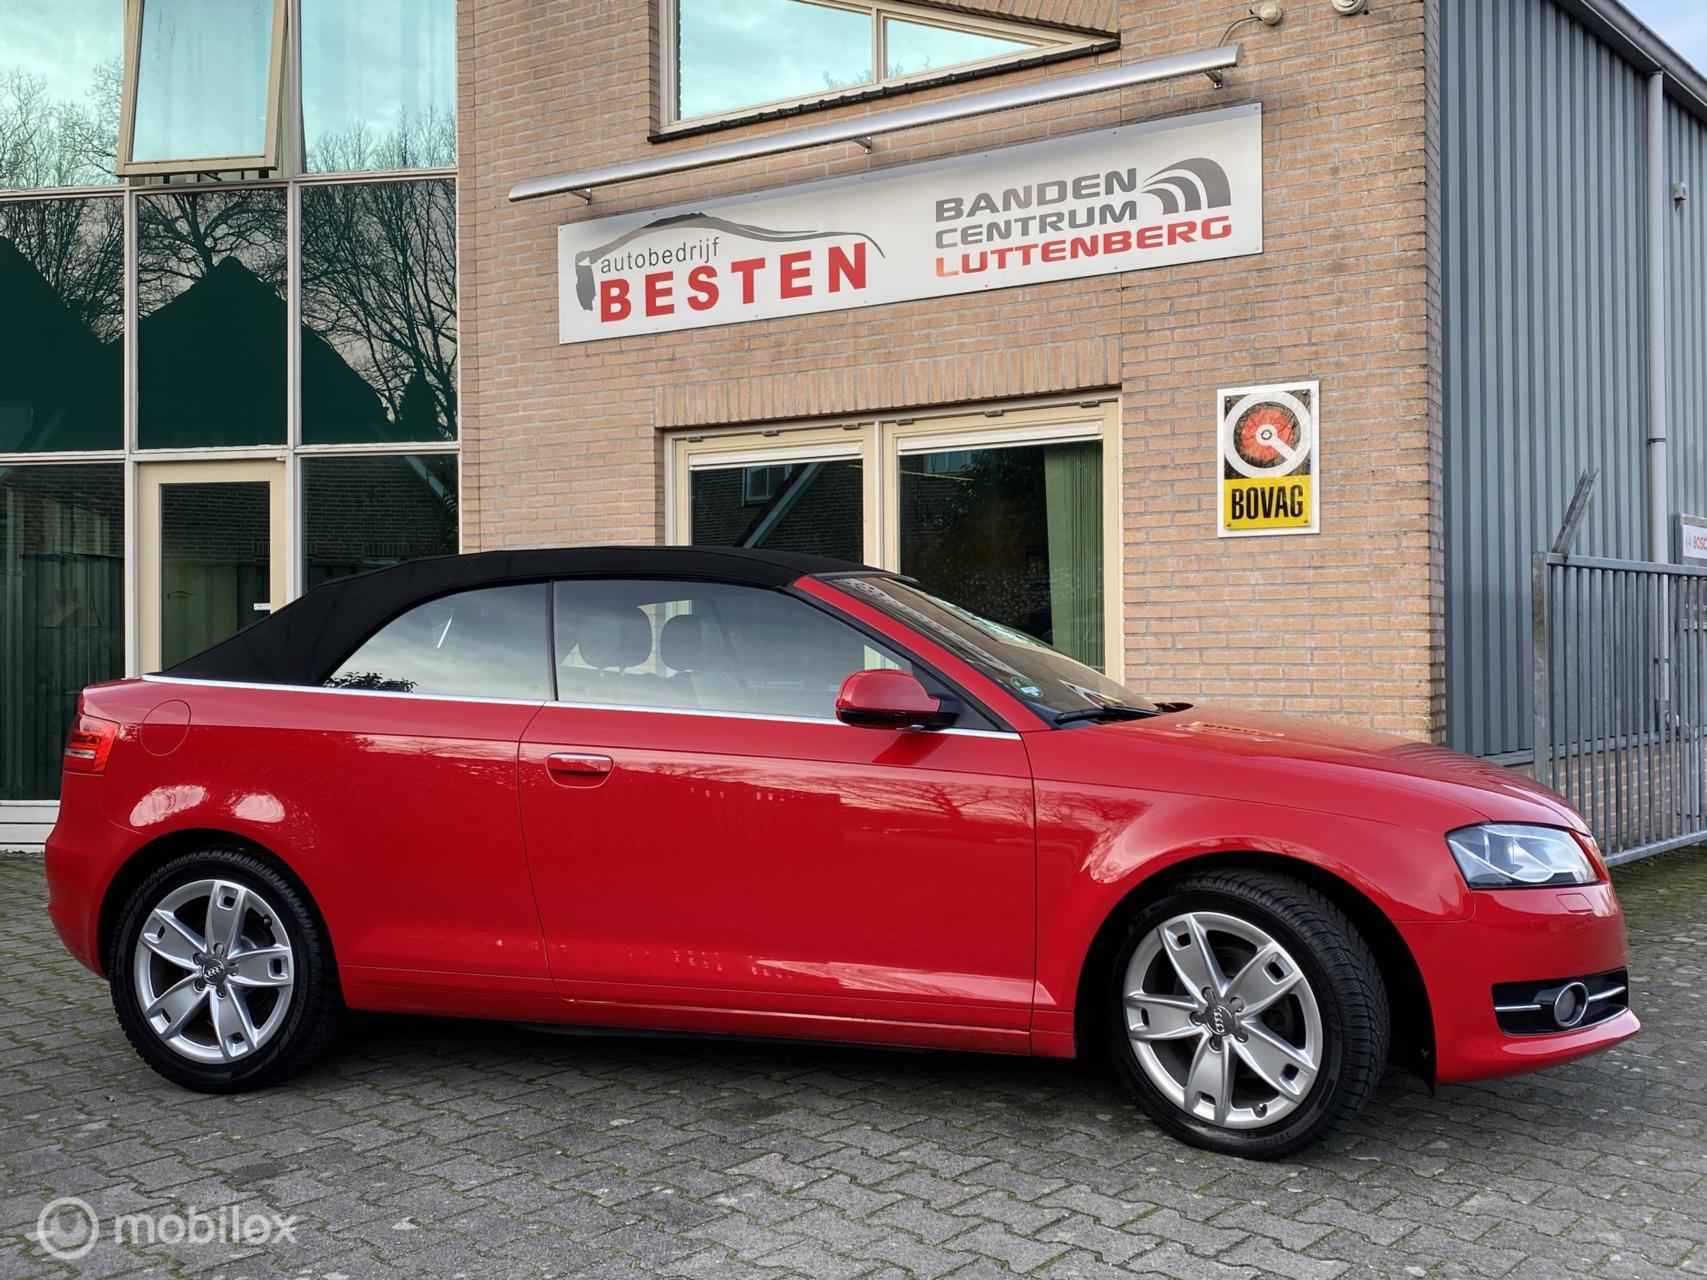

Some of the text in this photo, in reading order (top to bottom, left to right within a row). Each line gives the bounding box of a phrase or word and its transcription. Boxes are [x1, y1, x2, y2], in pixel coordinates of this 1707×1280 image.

[936, 168, 1137, 222] BANDEN
[936, 201, 1137, 249] CENTRUM
[936, 215, 1232, 278] LUTTENBERG
[601, 237, 719, 274] autobedrijf
[600, 242, 866, 323] BESTEN
[1231, 484, 1304, 520] BOVAG
